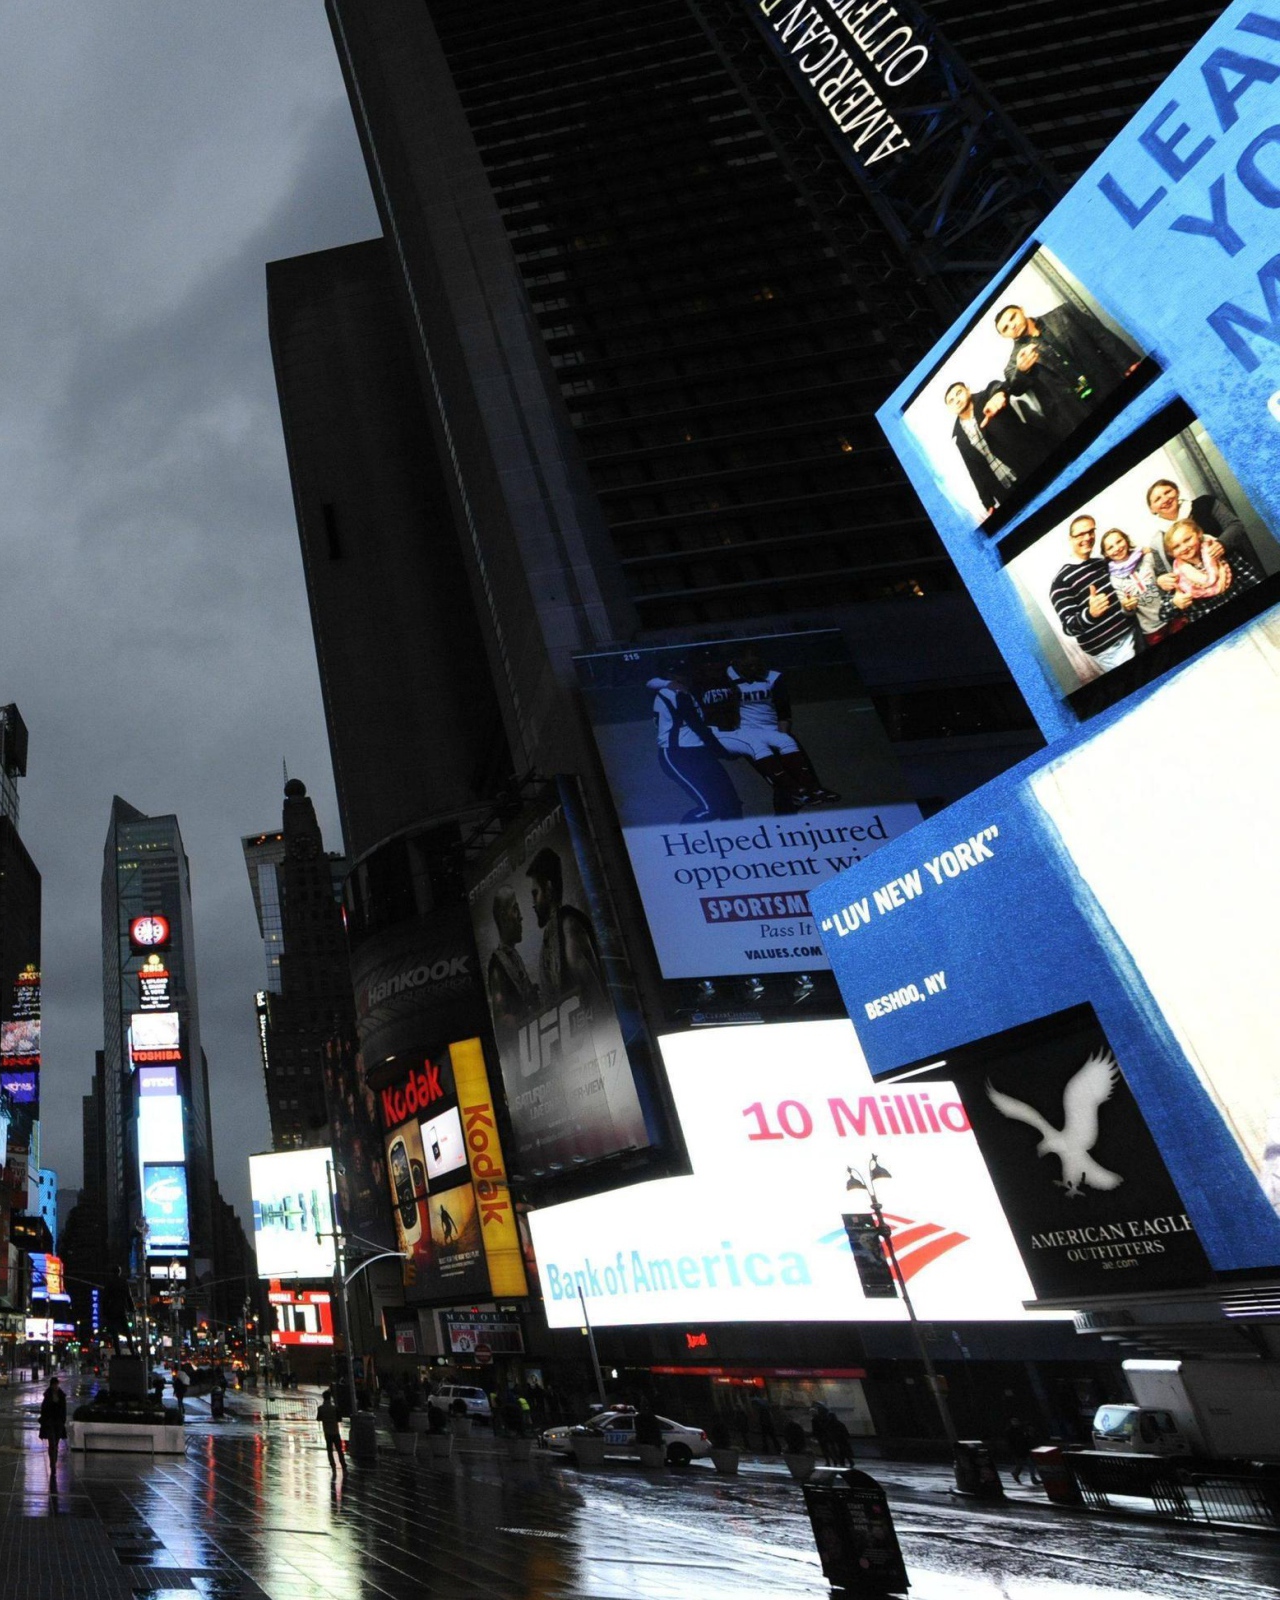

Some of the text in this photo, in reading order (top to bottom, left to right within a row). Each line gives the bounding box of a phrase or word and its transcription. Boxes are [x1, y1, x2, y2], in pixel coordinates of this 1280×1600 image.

[773, 0, 911, 167] AMERICAN
[661, 815, 889, 860] Helped injured
[674, 856, 821, 891] opponent
[872, 868, 923, 915] NEW
[760, 922, 813, 939] Pass It
[744, 945, 823, 961] VALUES.COM
[863, 970, 947, 1021] BESHOO, NY
[132, 1050, 182, 1061] TOSHIBA
[518, 996, 580, 1078] UFC
[381, 1058, 444, 1128] Kodak
[742, 1098, 814, 1142] 10
[462, 1102, 510, 1226] Kodak
[1030, 1222, 1126, 1250] AMERICAN
[1067, 1239, 1166, 1262] OUTFITTERS
[546, 1241, 813, 1301] Bank of America
[1102, 1257, 1139, 1270] ae.com
